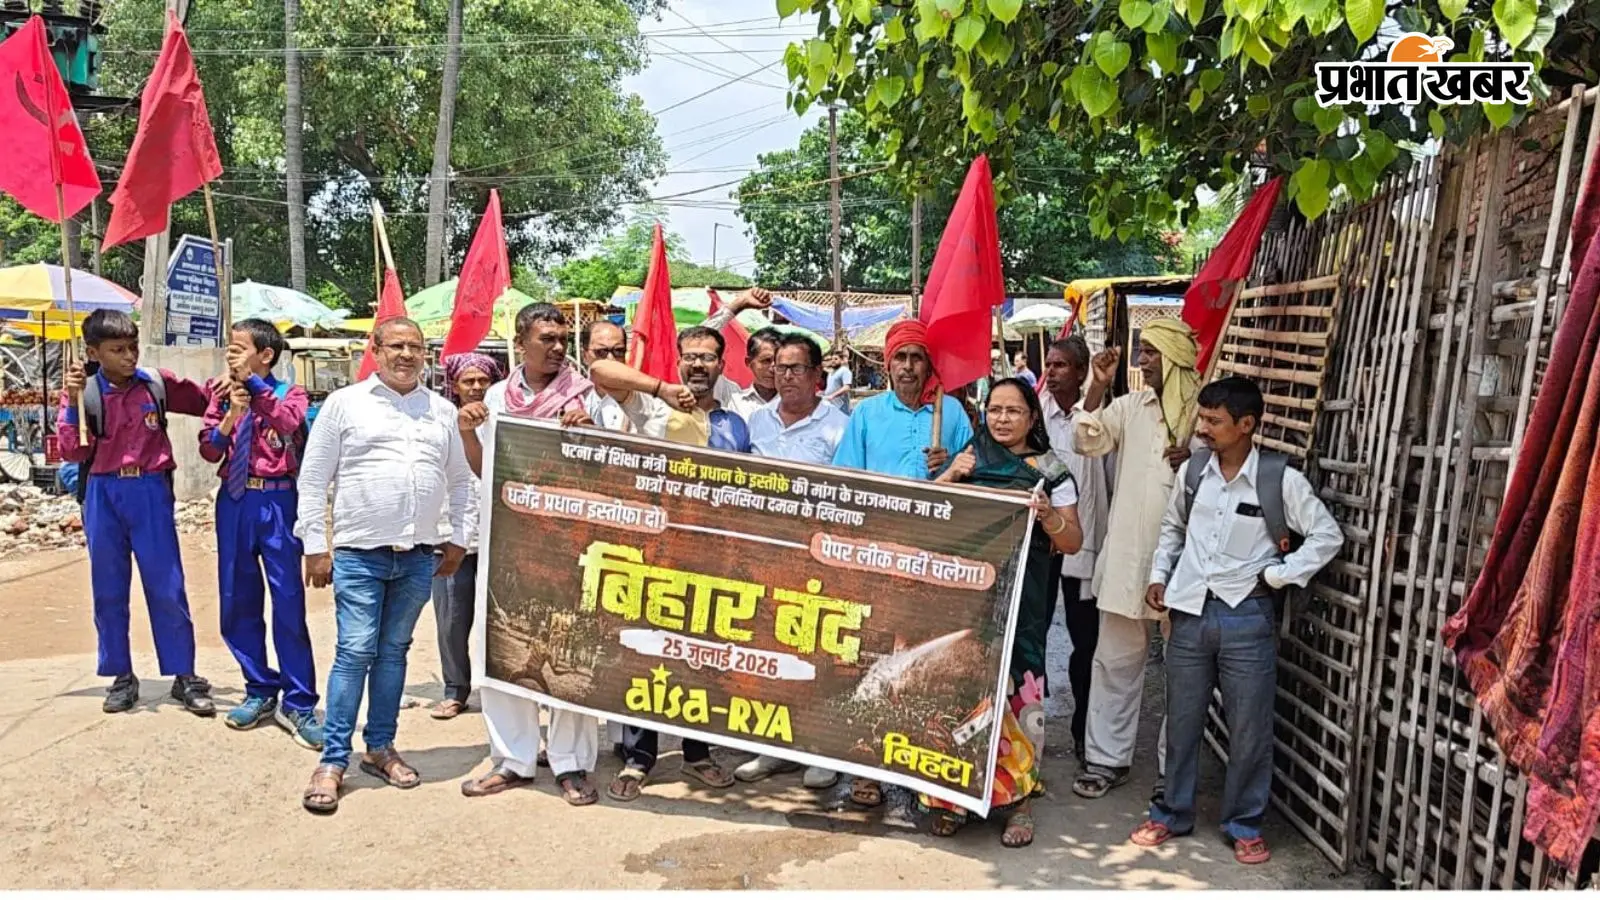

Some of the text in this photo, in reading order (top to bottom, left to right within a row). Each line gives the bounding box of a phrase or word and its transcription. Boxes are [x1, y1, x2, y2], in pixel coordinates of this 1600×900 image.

[561, 442, 591, 461] पटना
[593, 444, 608, 463] में
[608, 447, 640, 469] शिक्षा
[641, 453, 668, 473] मंत्री
[699, 464, 733, 484] प्रधान
[734, 466, 748, 486] के
[792, 477, 809, 497] की
[810, 481, 837, 501] मांग
[838, 484, 854, 503] के
[854, 489, 912, 514] राजभवन
[914, 499, 931, 518] जा
[933, 502, 953, 521] रहे
[635, 475, 866, 527] छात्रों पर बर्बर पुलिसिया दमन के खिलाफ
[544, 492, 586, 516] प्रधान
[645, 505, 668, 531] दो!
[820, 533, 986, 585] पेपर लीक नहीं चलेगा!
[578, 541, 872, 664] बिहार बंद
[662, 637, 779, 676] 25 जुलाई 2026
[883, 731, 974, 788] बिहटा
